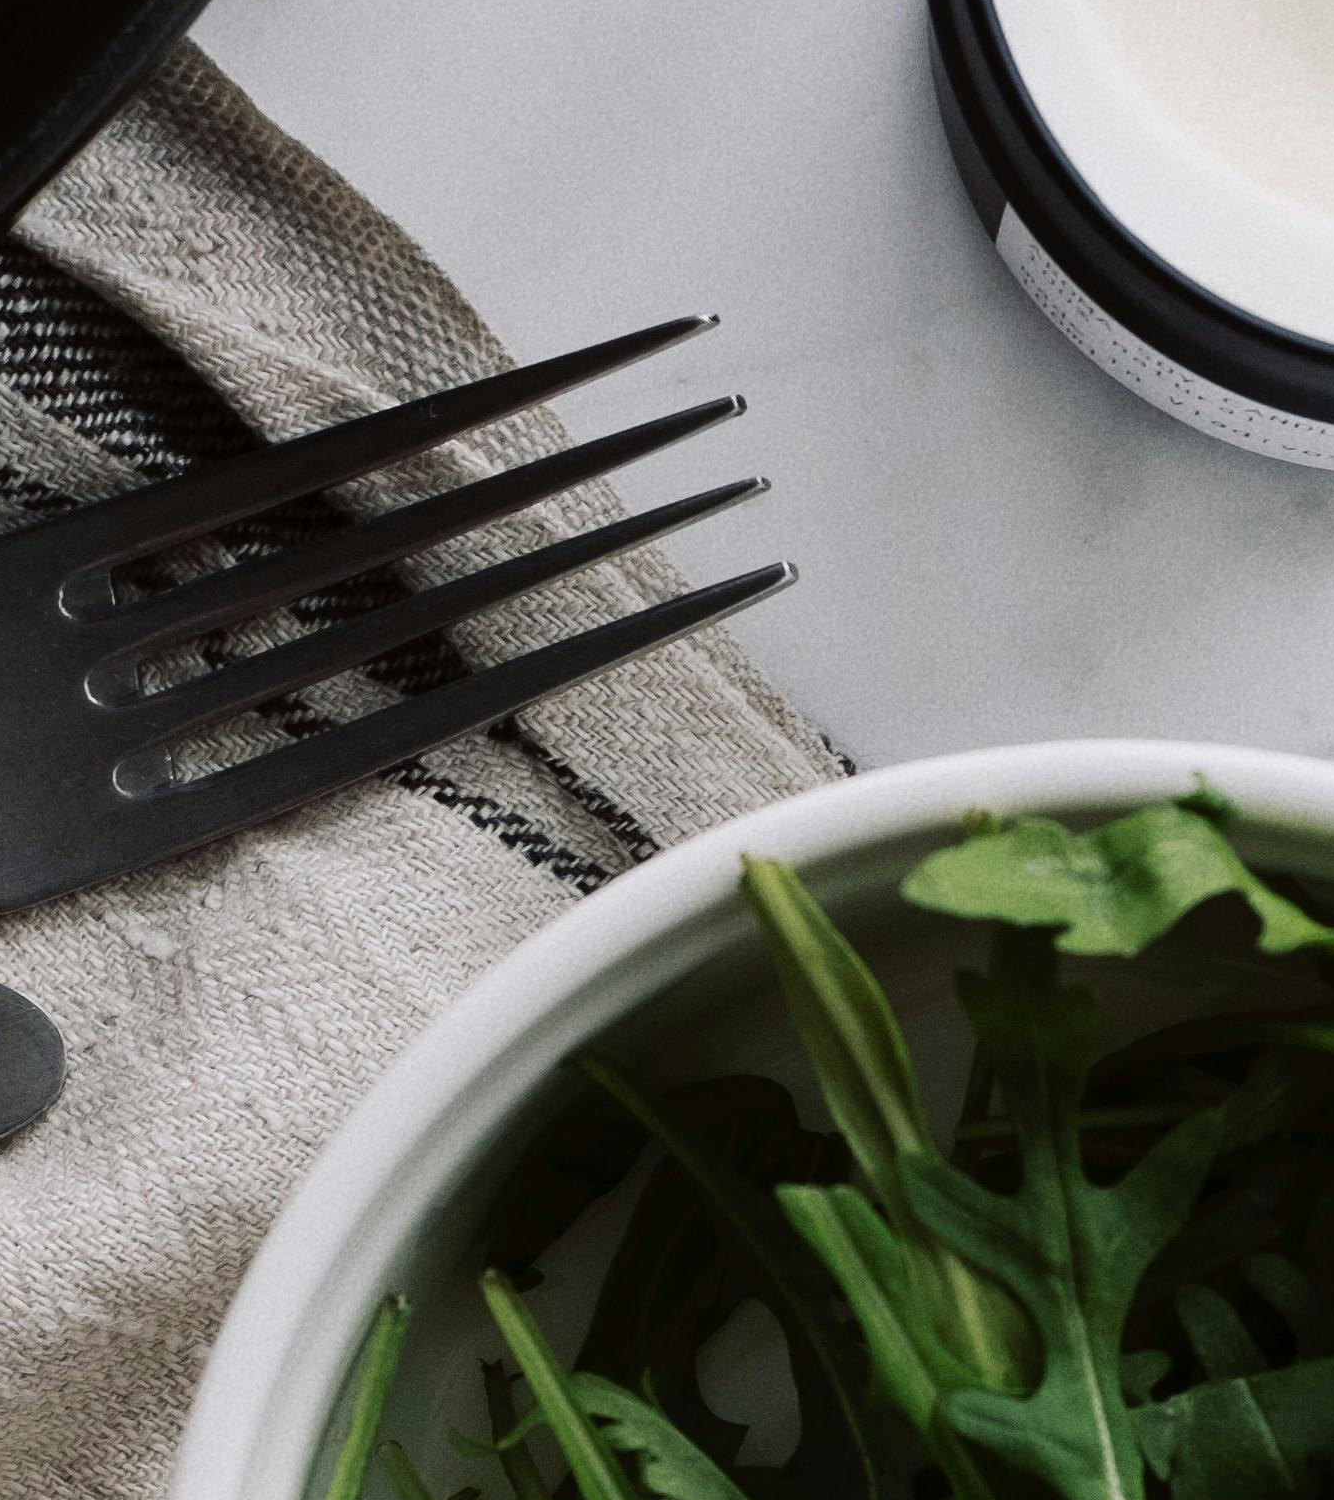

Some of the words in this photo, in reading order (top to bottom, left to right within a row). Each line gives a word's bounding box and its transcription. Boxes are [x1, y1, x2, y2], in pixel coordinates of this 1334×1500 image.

[1028, 242, 1111, 332] AROMA
[1136, 346, 1195, 382] SOY
[1112, 339, 1255, 423] natural
